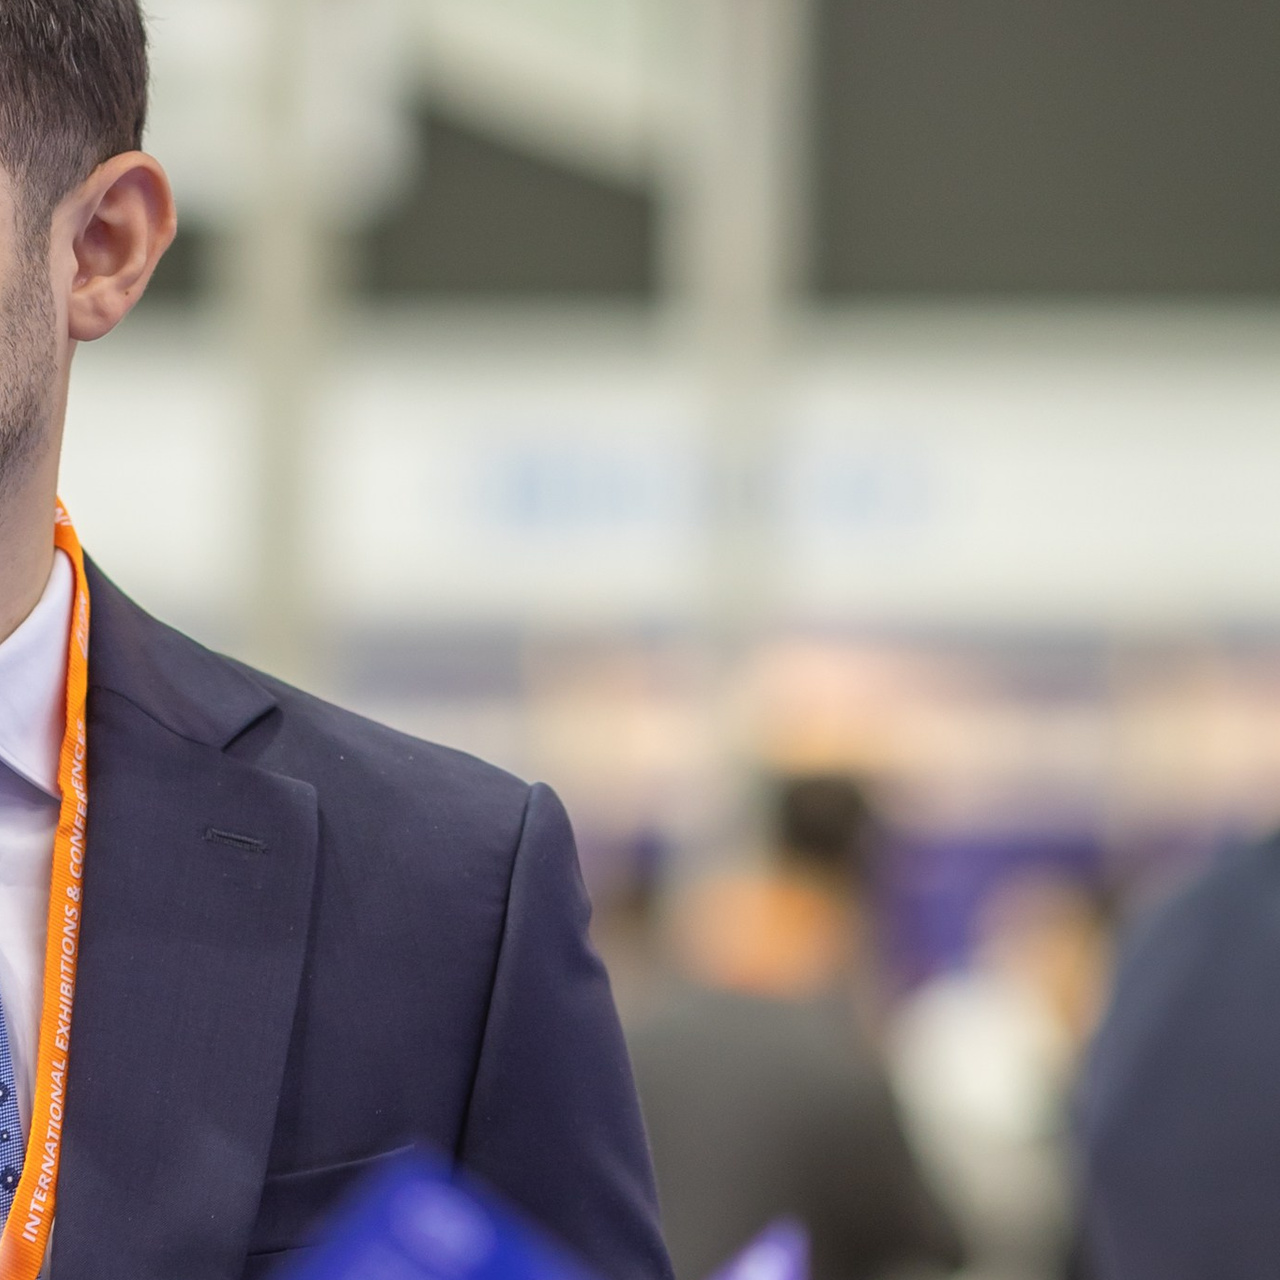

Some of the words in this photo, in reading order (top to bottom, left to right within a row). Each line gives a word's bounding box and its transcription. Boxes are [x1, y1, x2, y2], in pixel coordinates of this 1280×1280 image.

[69, 718, 88, 879] CONFERENCES
[66, 886, 82, 902] &
[55, 904, 79, 1052] EXHIBITIONS
[22, 1059, 66, 1243] INTERNATIONAL
